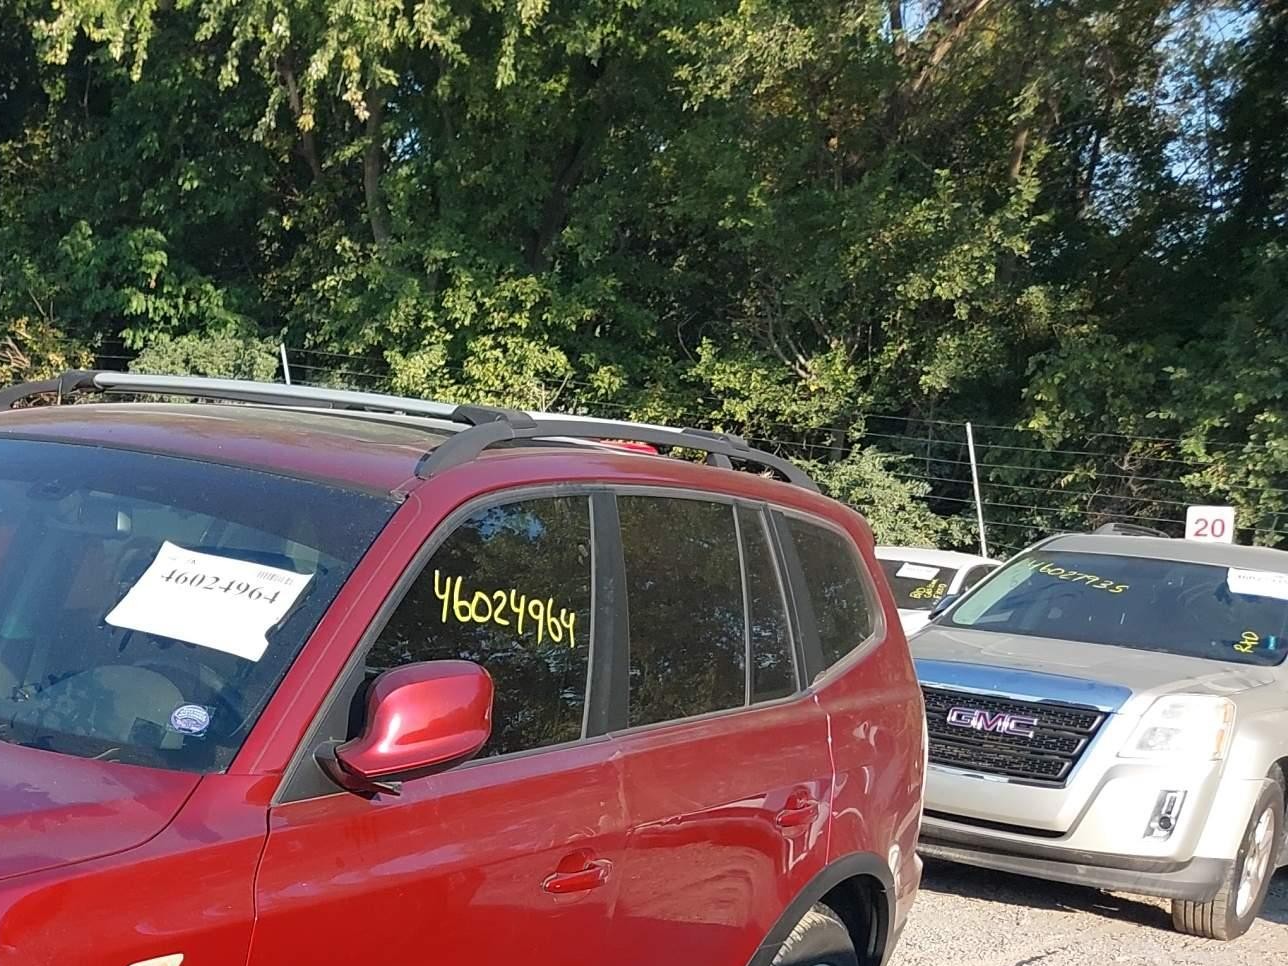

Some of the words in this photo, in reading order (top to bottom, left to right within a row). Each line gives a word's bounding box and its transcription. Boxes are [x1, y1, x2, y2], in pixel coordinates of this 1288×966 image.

[1193, 518, 1225, 538] 20
[161, 568, 281, 604] 46024964
[434, 569, 576, 648] 46024964
[946, 706, 1039, 739] GMC
